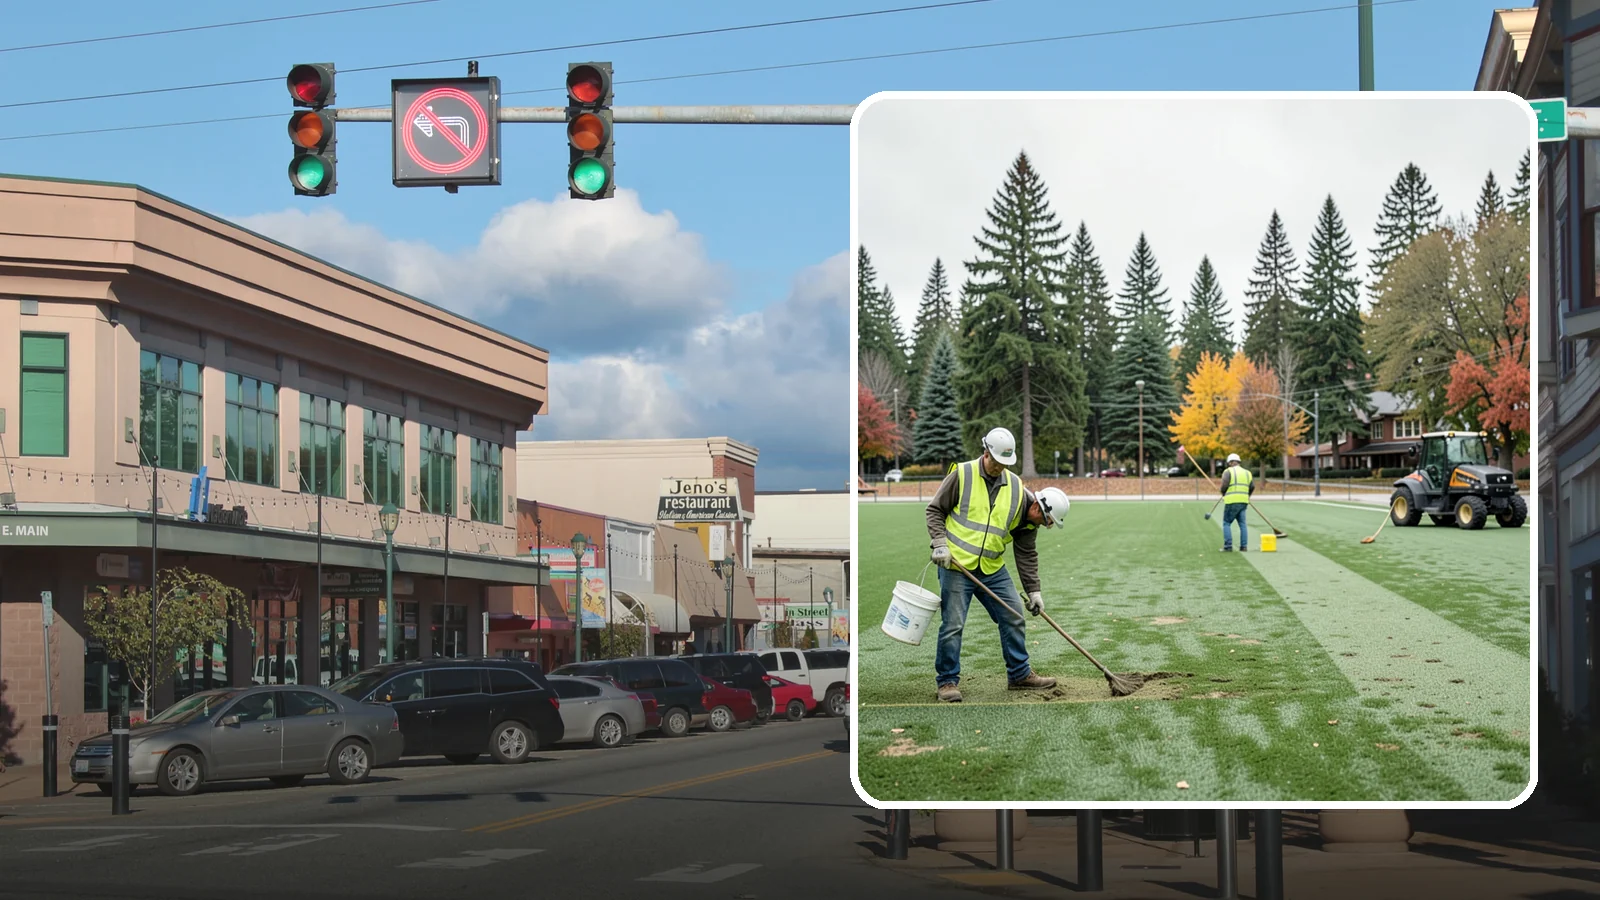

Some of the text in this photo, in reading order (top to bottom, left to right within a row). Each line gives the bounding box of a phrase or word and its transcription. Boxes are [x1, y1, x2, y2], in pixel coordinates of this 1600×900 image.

[669, 480, 727, 494] Jeno's
[665, 496, 731, 509] restaurant
[659, 509, 682, 519] Italian
[686, 509, 714, 519] American
[715, 509, 737, 519] Cuisine
[2, 525, 49, 536] E. MAIN
[797, 607, 828, 616] Street
